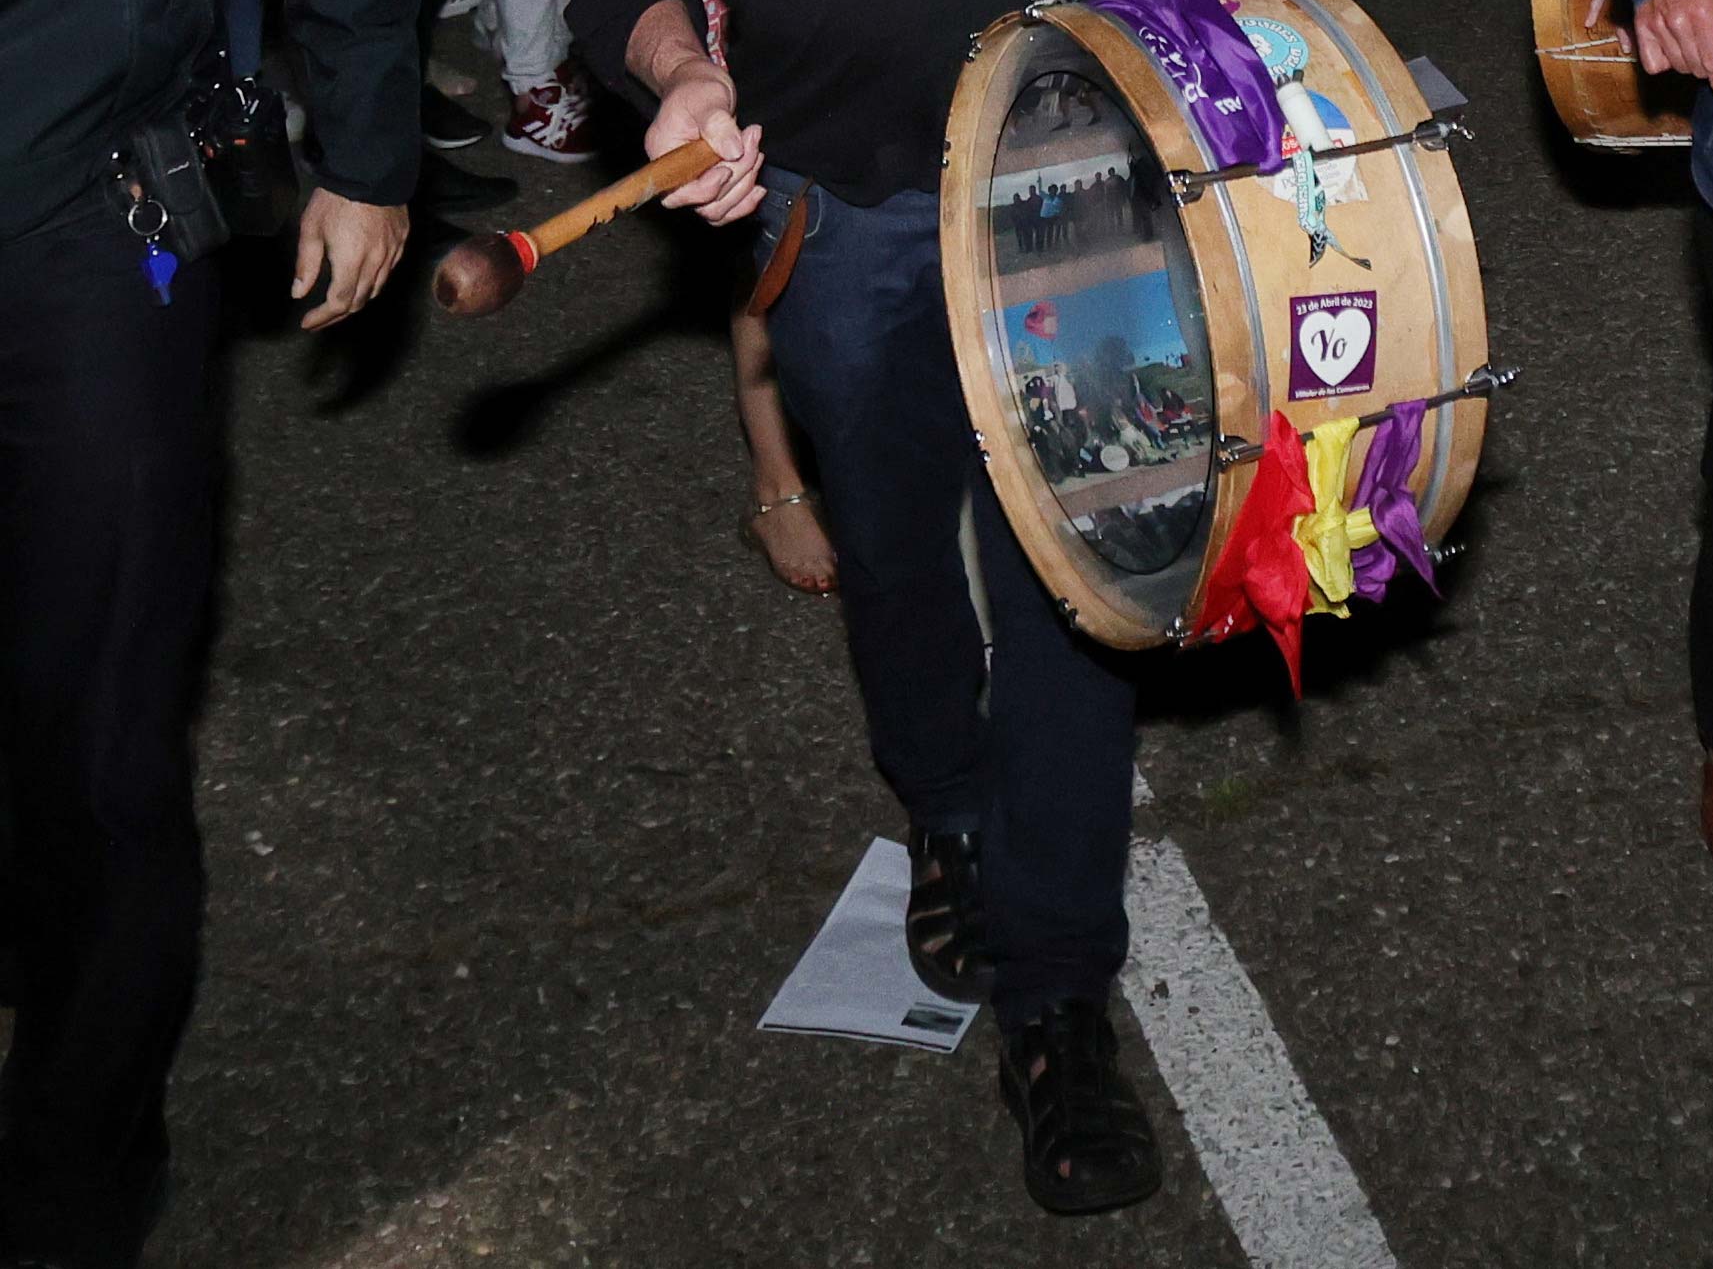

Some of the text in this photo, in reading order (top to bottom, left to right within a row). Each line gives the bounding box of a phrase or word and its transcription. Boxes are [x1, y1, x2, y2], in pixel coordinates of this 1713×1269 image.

[1296, 295, 1373, 316] 23 de Abril de 2023
[1311, 328, 1348, 363] Yo
